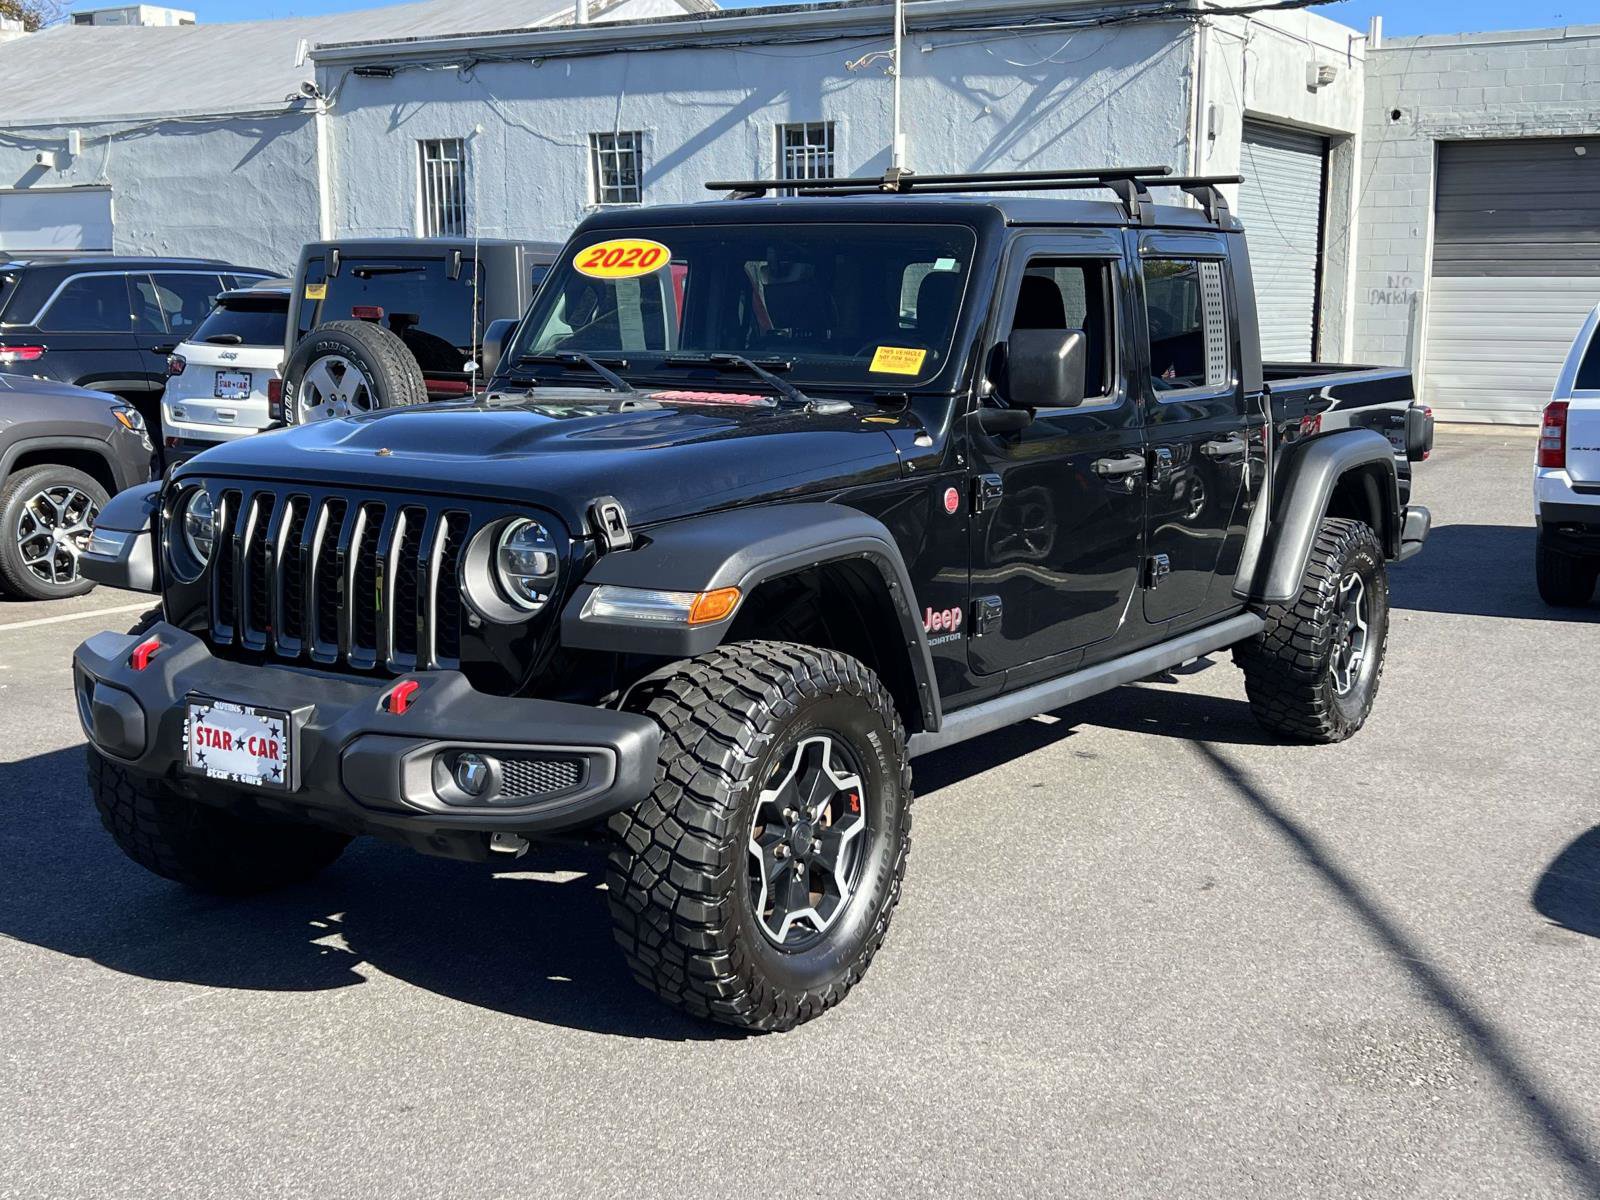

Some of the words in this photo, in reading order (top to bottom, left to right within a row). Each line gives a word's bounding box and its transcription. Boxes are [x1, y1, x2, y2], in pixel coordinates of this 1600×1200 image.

[581, 248, 661, 268] 2020
[921, 606, 963, 633] Jeep
[927, 632, 961, 647] ADIATOR
[196, 725, 233, 751] STAR
[248, 736, 280, 761] CAR
